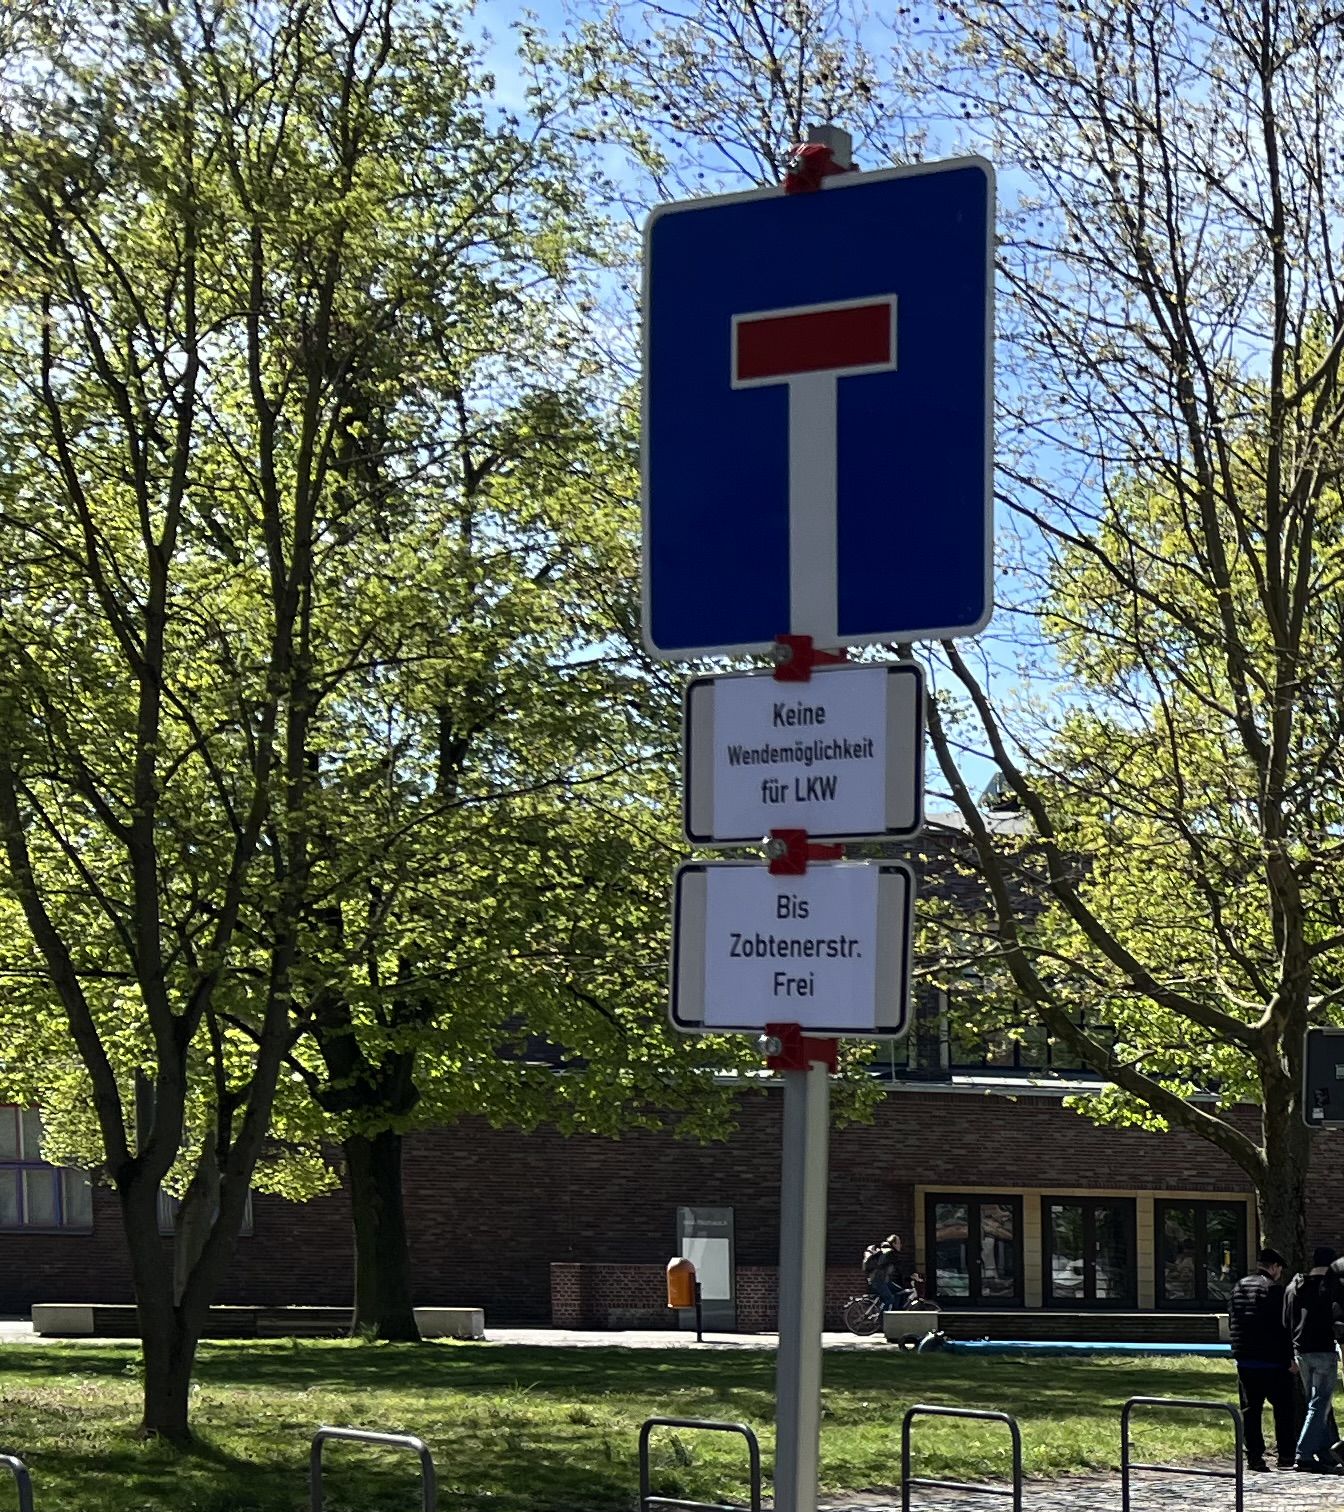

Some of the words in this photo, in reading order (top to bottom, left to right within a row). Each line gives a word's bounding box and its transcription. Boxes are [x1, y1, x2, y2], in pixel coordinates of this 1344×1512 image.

[773, 702, 826, 727] Keine
[727, 738, 874, 766] Wendemöglichkeit
[762, 779, 789, 803] für
[795, 776, 838, 802] LKW
[776, 895, 810, 919] Bis
[729, 933, 862, 958] Zobtenerstr.
[773, 972, 815, 997] Frei
